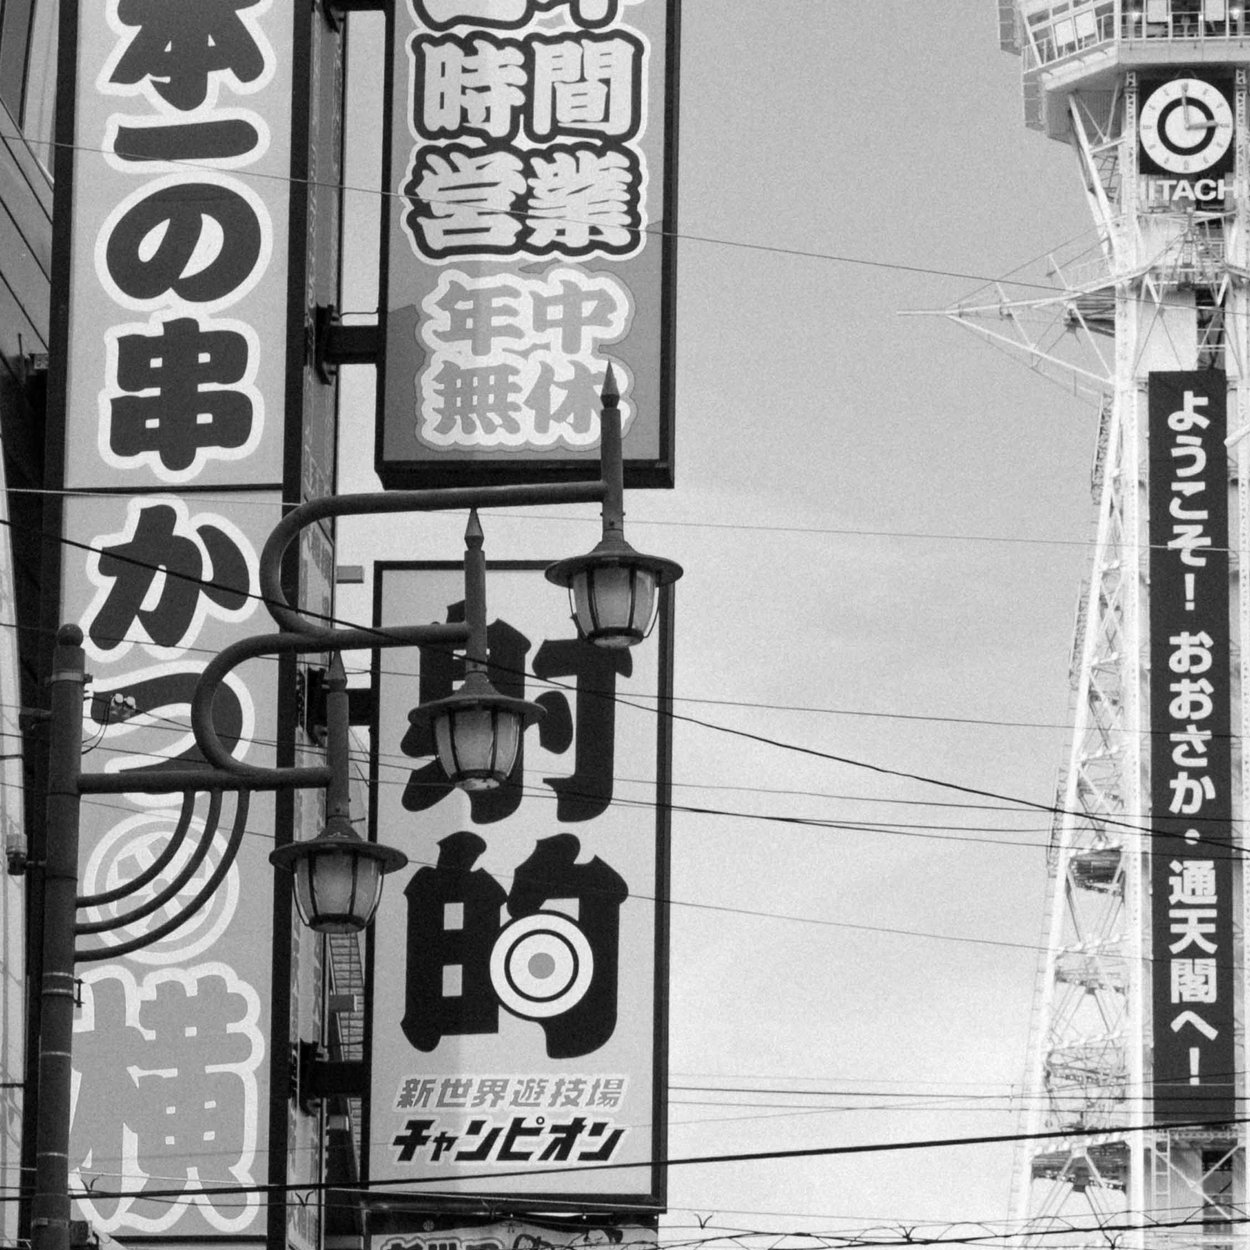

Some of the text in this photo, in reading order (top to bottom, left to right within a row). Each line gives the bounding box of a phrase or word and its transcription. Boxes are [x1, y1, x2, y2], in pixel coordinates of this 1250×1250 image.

[412, 34, 646, 140] 時間
[404, 146, 644, 256] 営業
[424, 275, 628, 357] 年中
[396, 1076, 626, 1110] 新世界遊技場
[393, 1115, 625, 1163] チャンピオン
